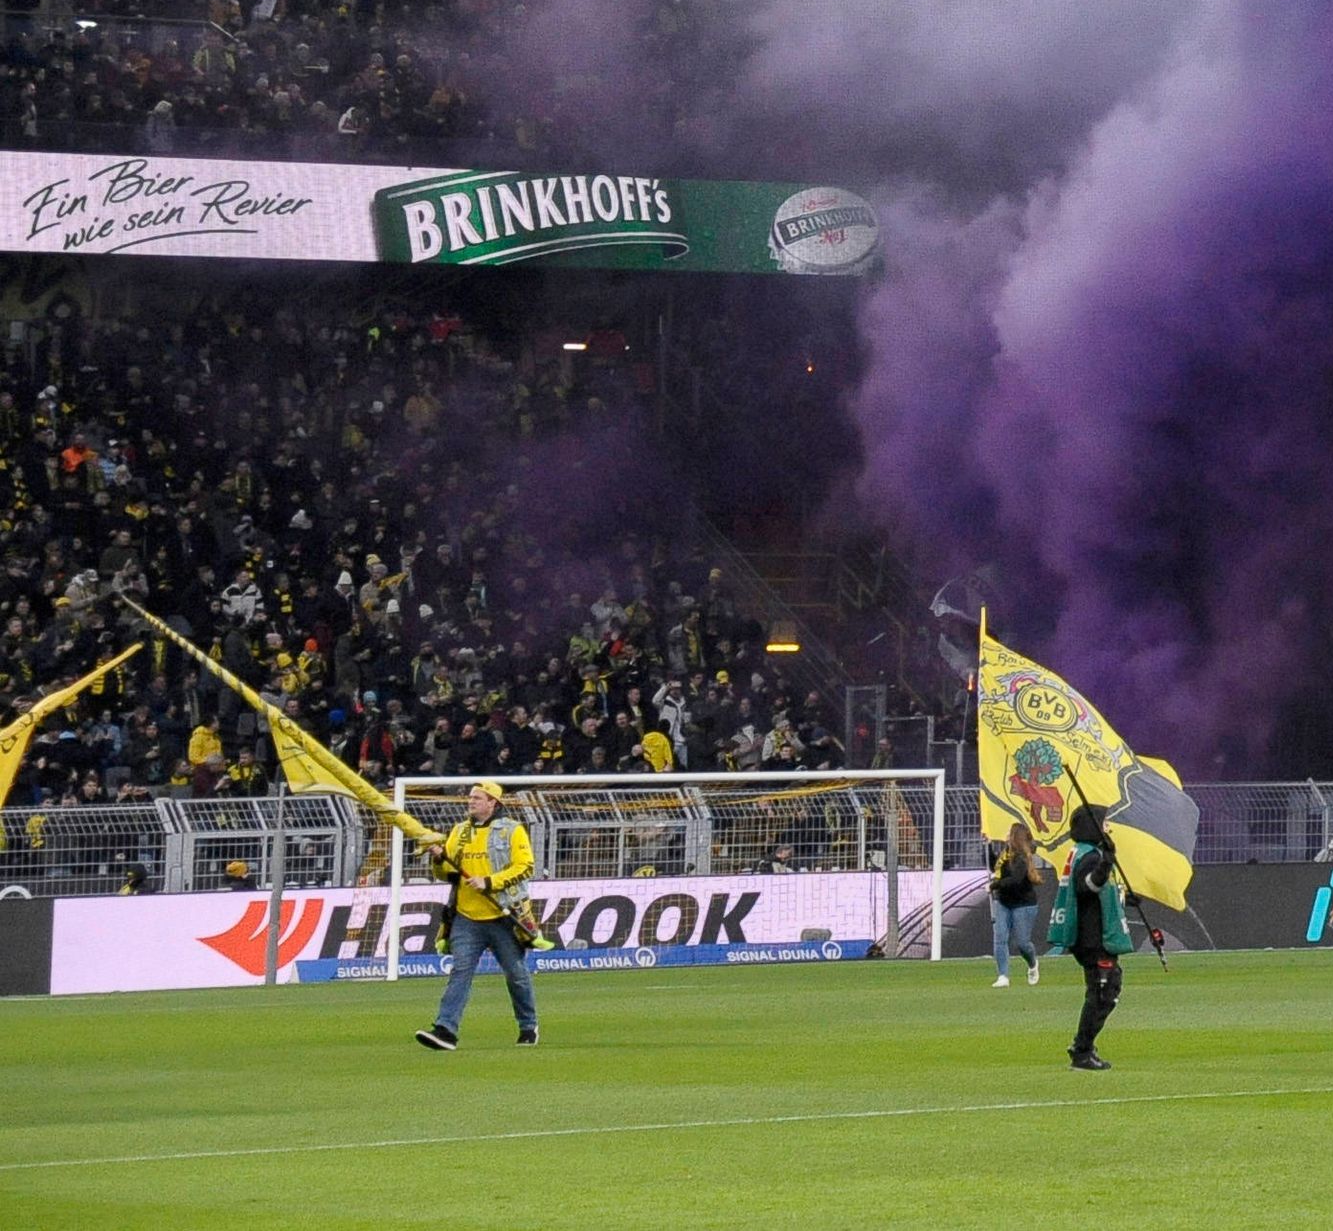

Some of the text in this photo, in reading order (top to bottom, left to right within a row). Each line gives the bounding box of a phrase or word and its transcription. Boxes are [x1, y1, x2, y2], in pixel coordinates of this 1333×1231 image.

[23, 158, 195, 242] Ein Bier
[62, 180, 314, 251] wie sein Revier
[1027, 690, 1067, 719] BVB
[536, 956, 633, 970] SIGNAL IDUNA
[726, 948, 818, 962] SIGNAL IDUNA
[398, 964, 435, 976] DUNA
